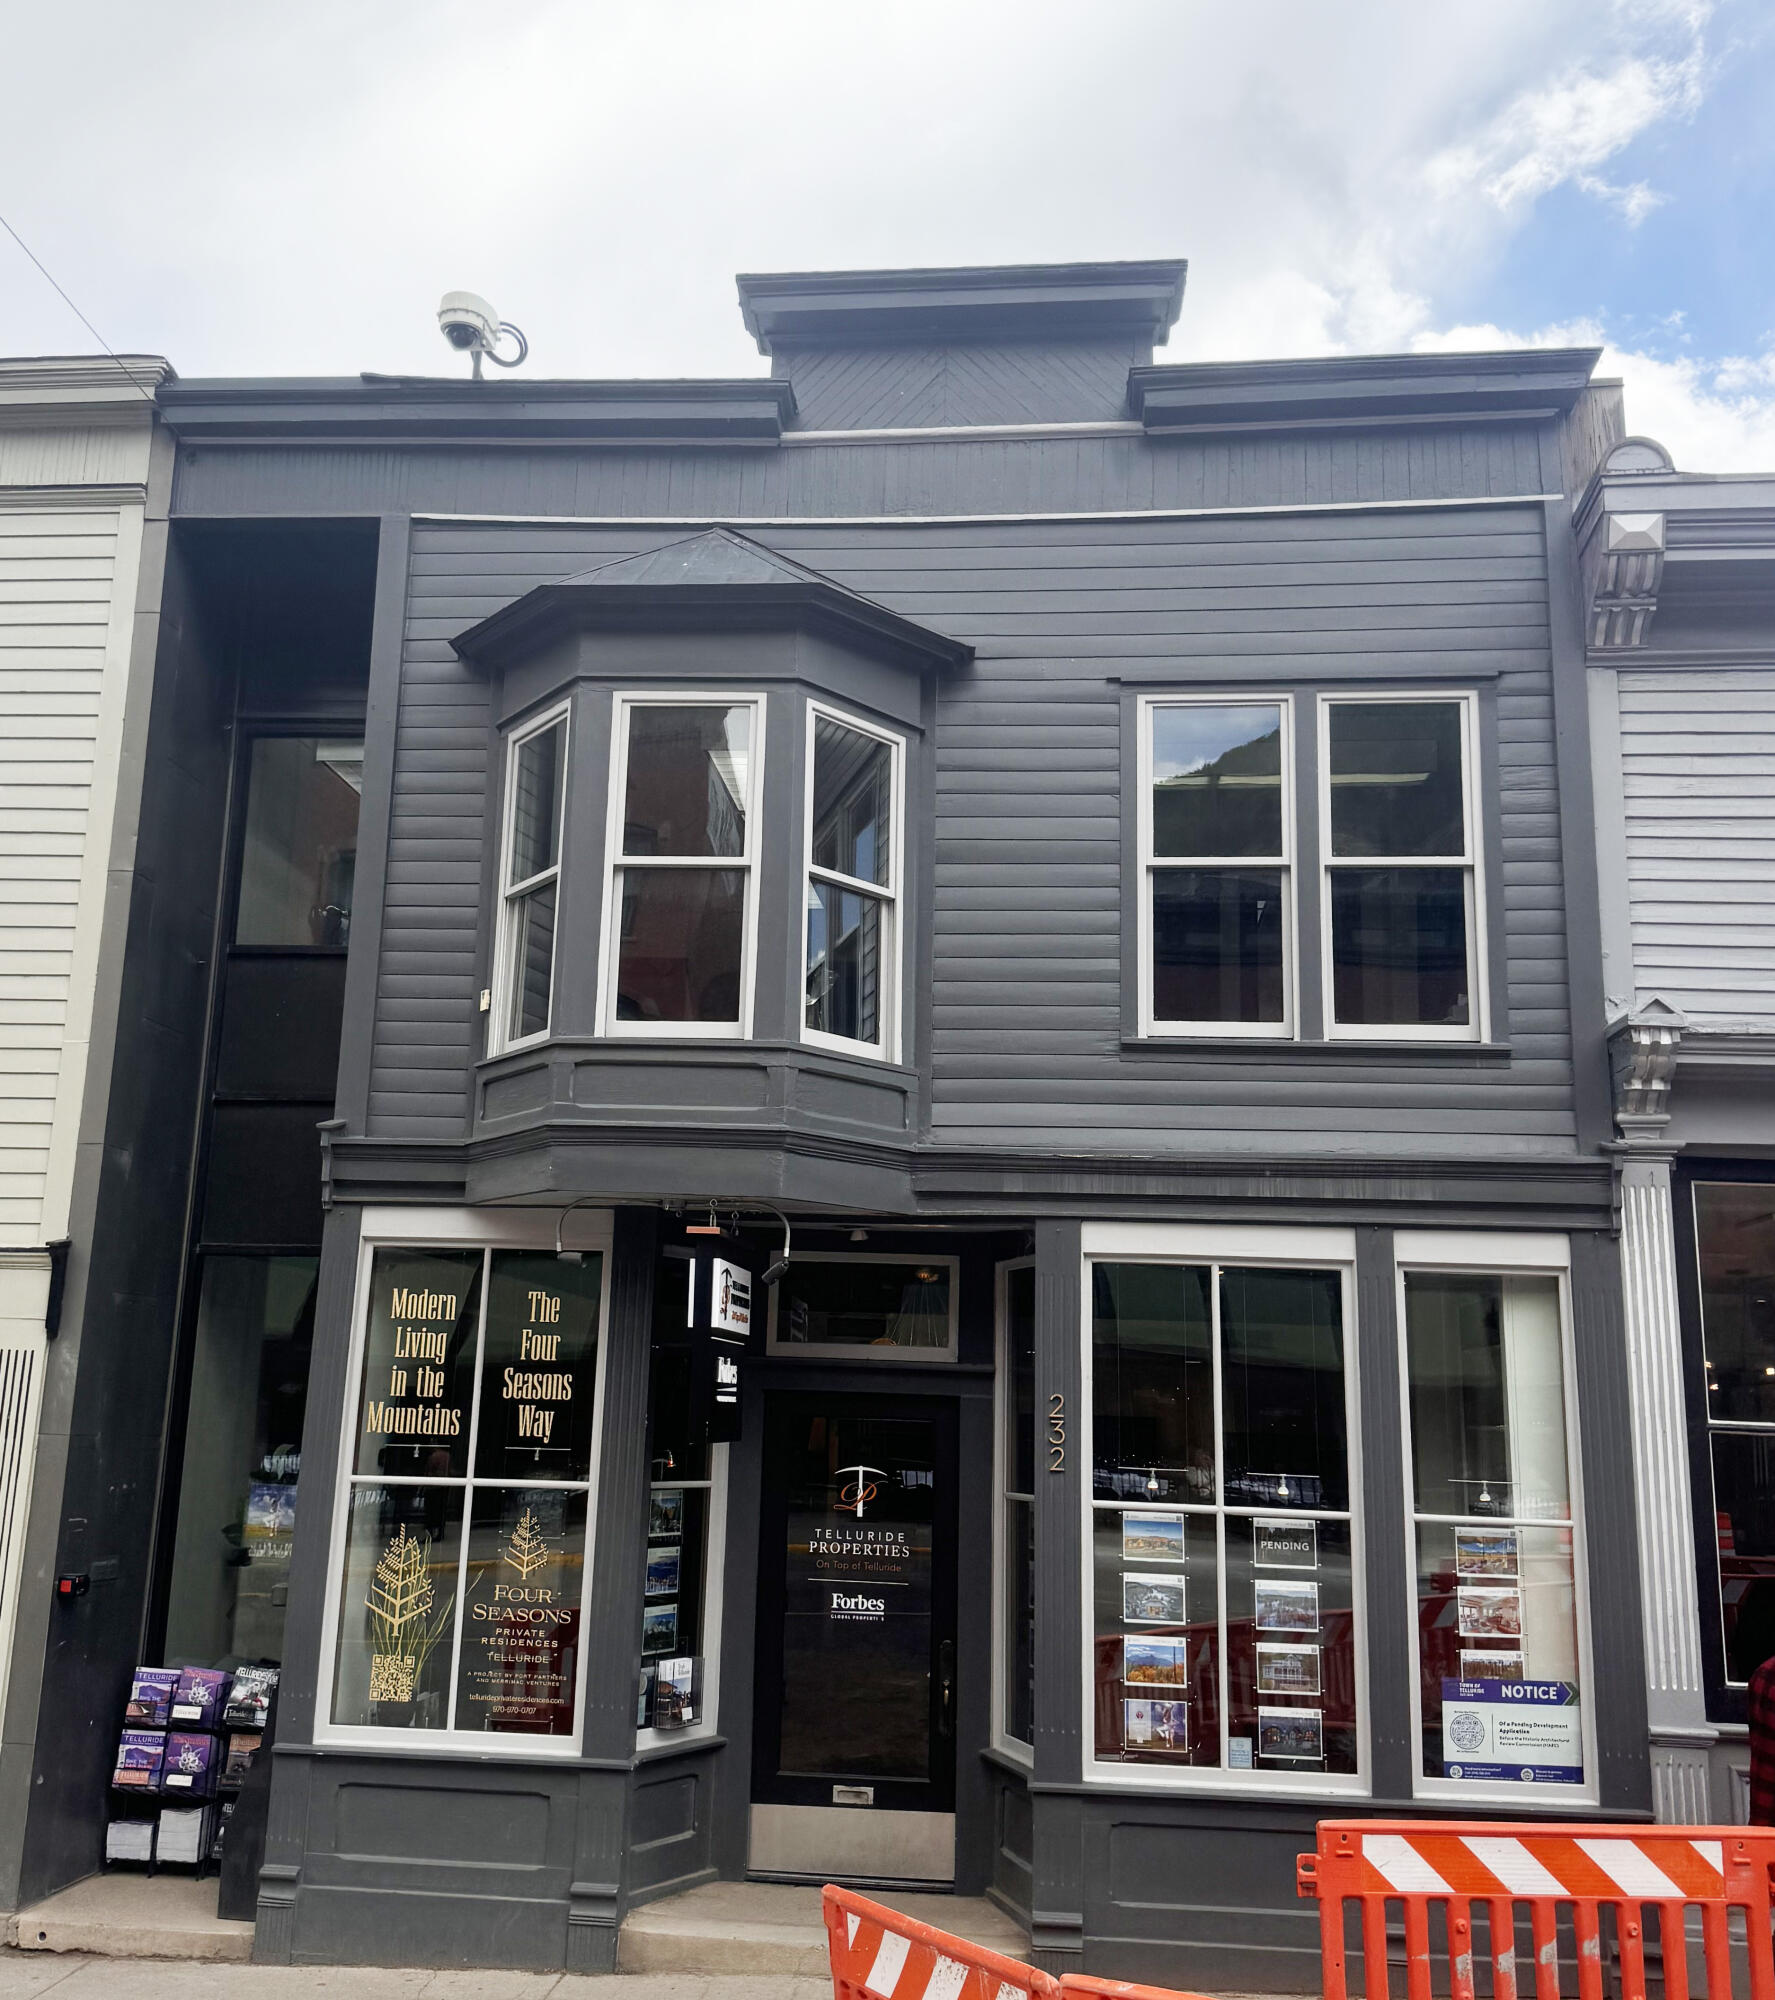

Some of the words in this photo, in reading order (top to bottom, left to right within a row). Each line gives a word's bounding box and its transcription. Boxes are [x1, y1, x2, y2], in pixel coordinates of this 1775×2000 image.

[390, 1287, 457, 1321] Modern
[528, 1291, 561, 1323] The
[394, 1326, 448, 1364] Living
[520, 1329, 561, 1361] Four
[389, 1365, 407, 1397] in
[416, 1365, 444, 1398] the
[502, 1367, 573, 1400] Seasons
[366, 1401, 461, 1435] Mountains
[518, 1404, 555, 1443] Way
[1048, 1393, 1065, 1471] 232
[815, 1528, 905, 1543] TELLURIDE
[809, 1540, 910, 1558] PROPERTIES
[1260, 1540, 1310, 1551] PENDING
[816, 1560, 830, 1569] On
[833, 1560, 849, 1571] Top
[852, 1561, 860, 1570] of
[864, 1561, 902, 1572] Telluride
[830, 1592, 885, 1611] Forbes
[495, 1627, 546, 1638] PRIVATE
[481, 1637, 558, 1648] RESIDENCES
[487, 1652, 549, 1664] TELLURIDE
[1501, 1684, 1558, 1700] NOTICE
[124, 1735, 164, 1744] TELLURIDE
